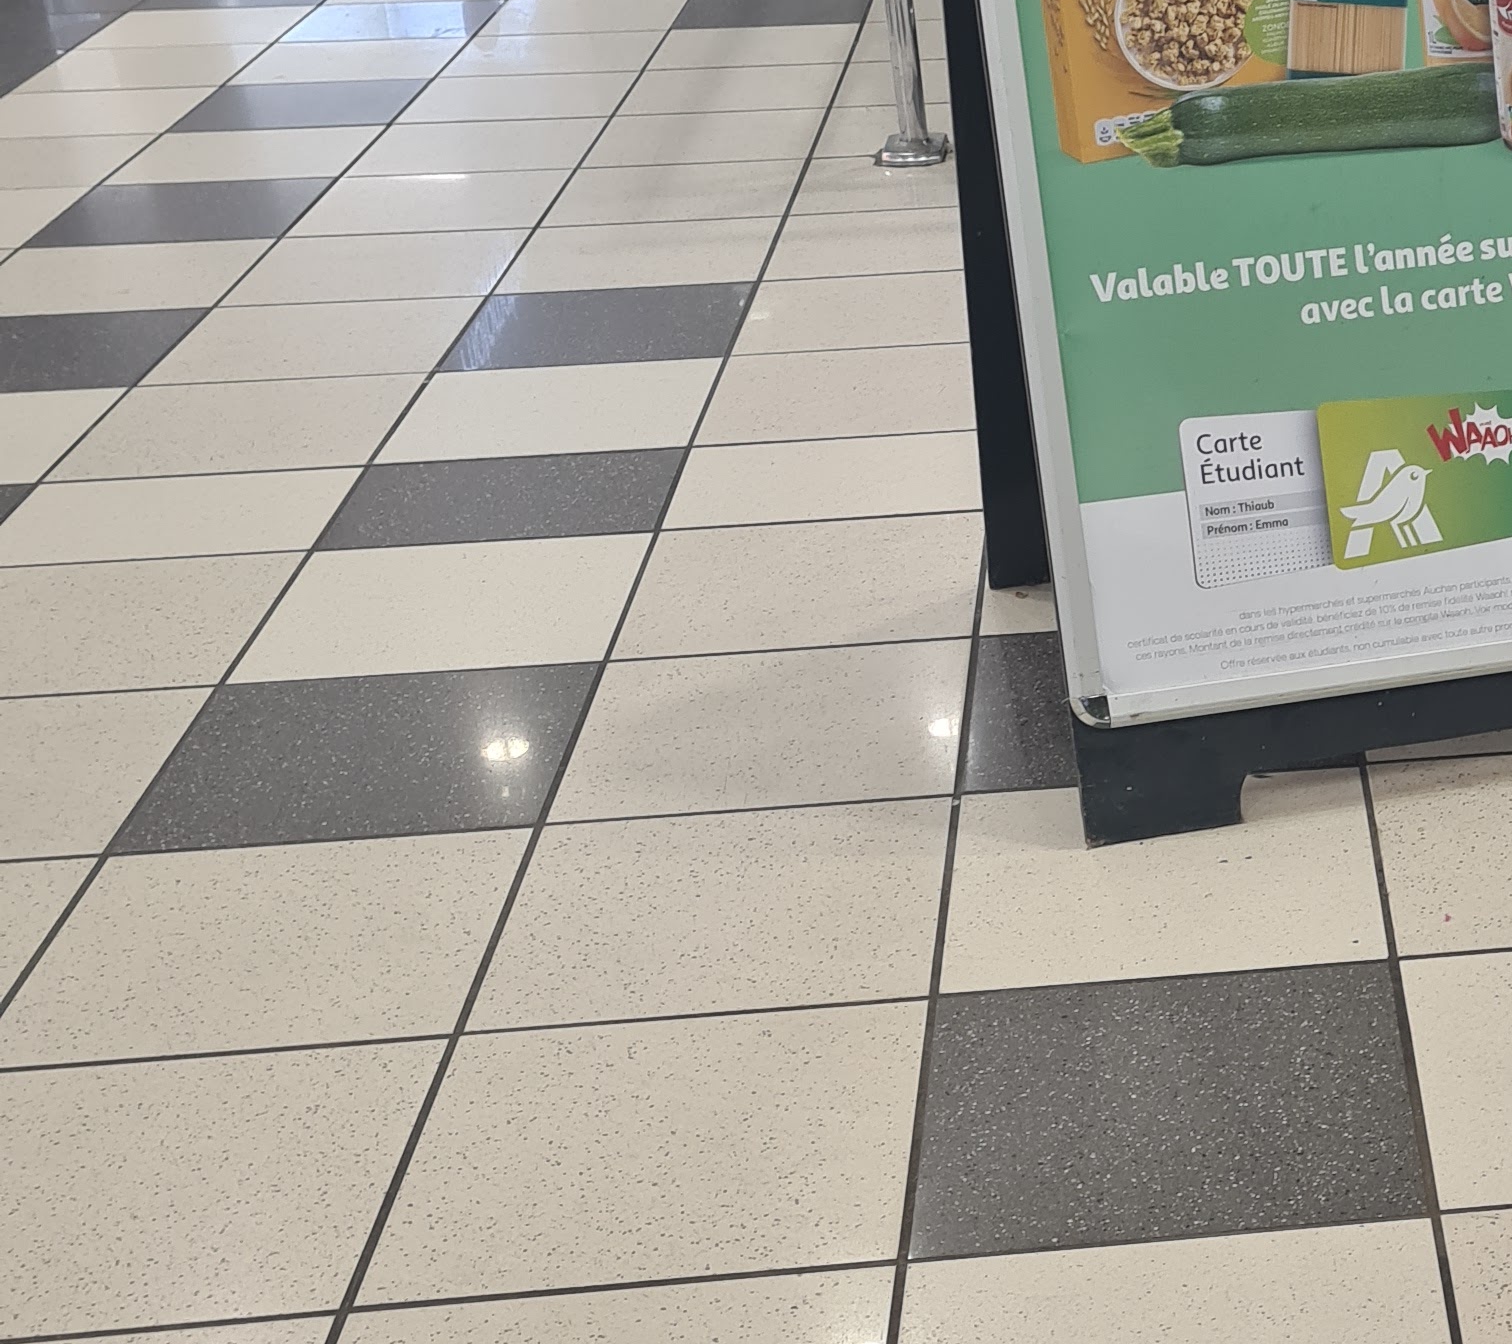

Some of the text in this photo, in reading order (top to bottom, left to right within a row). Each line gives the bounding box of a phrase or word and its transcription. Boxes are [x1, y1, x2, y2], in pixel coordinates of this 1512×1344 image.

[1089, 262, 1229, 303] Valable
[1232, 246, 1349, 287] TOUTE
[1353, 233, 1474, 275] l'année
[1300, 293, 1375, 325] avec
[1380, 285, 1414, 316] la
[1420, 277, 1504, 311] carte
[1196, 431, 1263, 455] Carte
[1200, 457, 1305, 485] Étudiant
[1205, 507, 1231, 517] Nom
[1207, 518, 1289, 535] Prénom Emma
[1422, 582, 1458, 595] Auchan
